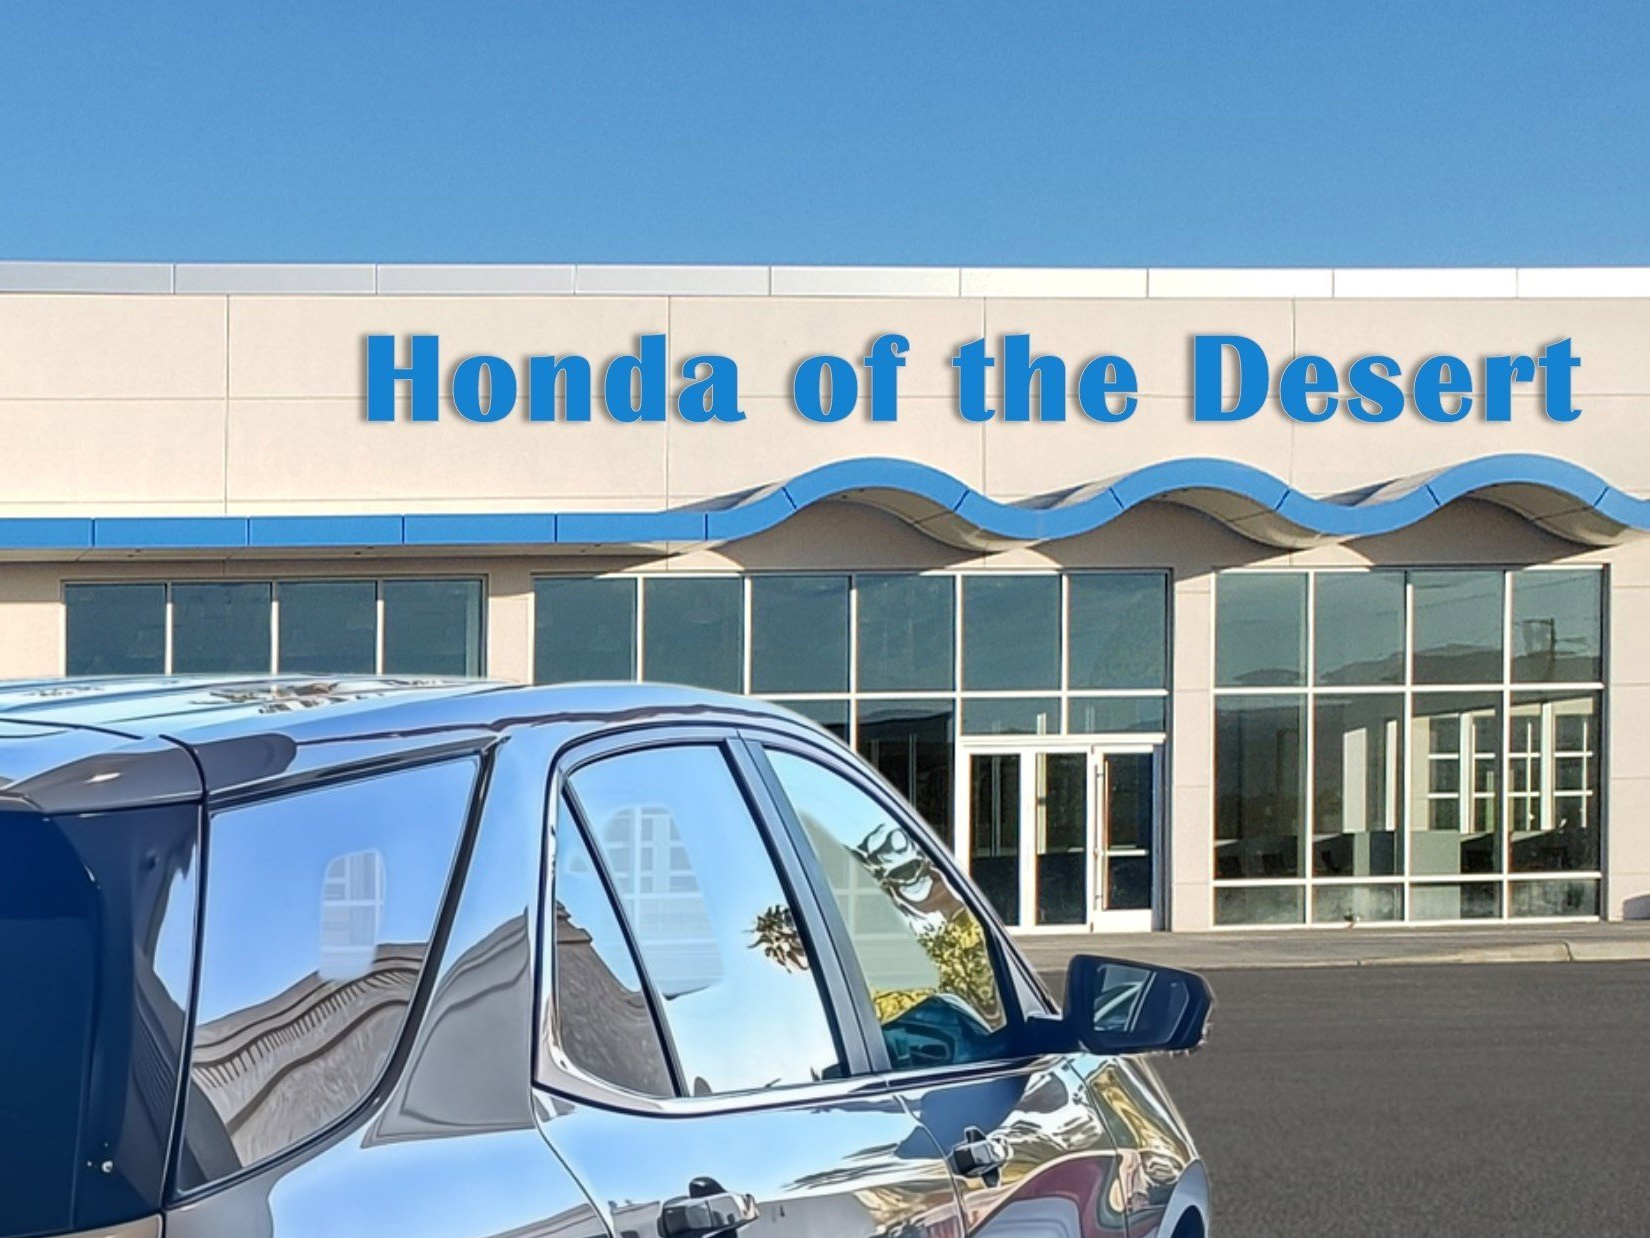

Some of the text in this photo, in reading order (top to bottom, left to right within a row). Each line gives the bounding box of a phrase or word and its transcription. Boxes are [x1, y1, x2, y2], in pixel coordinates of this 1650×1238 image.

[366, 333, 1583, 424] Honda of the Desert
